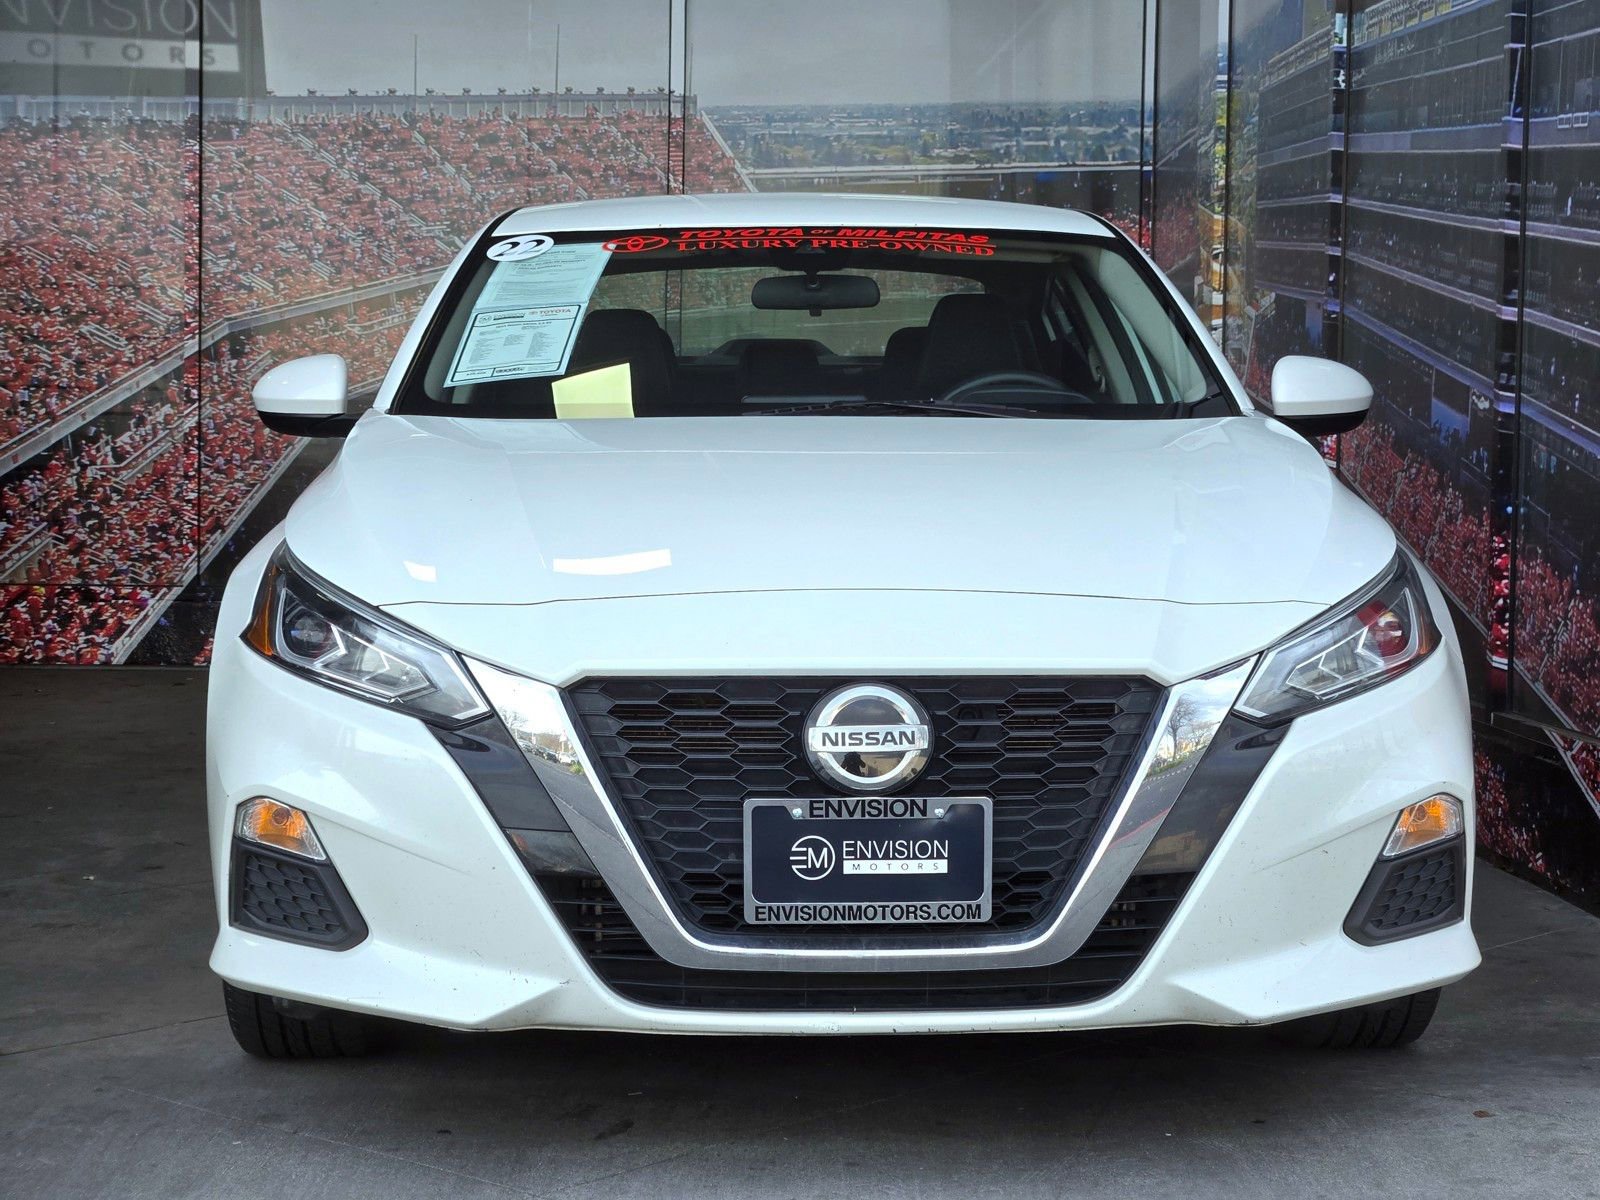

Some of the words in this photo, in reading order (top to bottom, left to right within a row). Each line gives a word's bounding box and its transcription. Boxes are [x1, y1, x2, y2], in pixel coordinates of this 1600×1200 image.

[680, 228, 803, 239] TOYOTA
[836, 228, 990, 243] MILPITAS
[492, 239, 546, 257] 22
[678, 239, 802, 251] LUXURY
[811, 239, 994, 257] PRE-OWNED
[821, 731, 916, 747] NISSAN
[808, 799, 928, 818] ENVISION
[842, 840, 949, 859] ENVISION
[852, 863, 939, 871] MOTORS
[754, 904, 982, 922] ENVISIONMOTORS.COM
